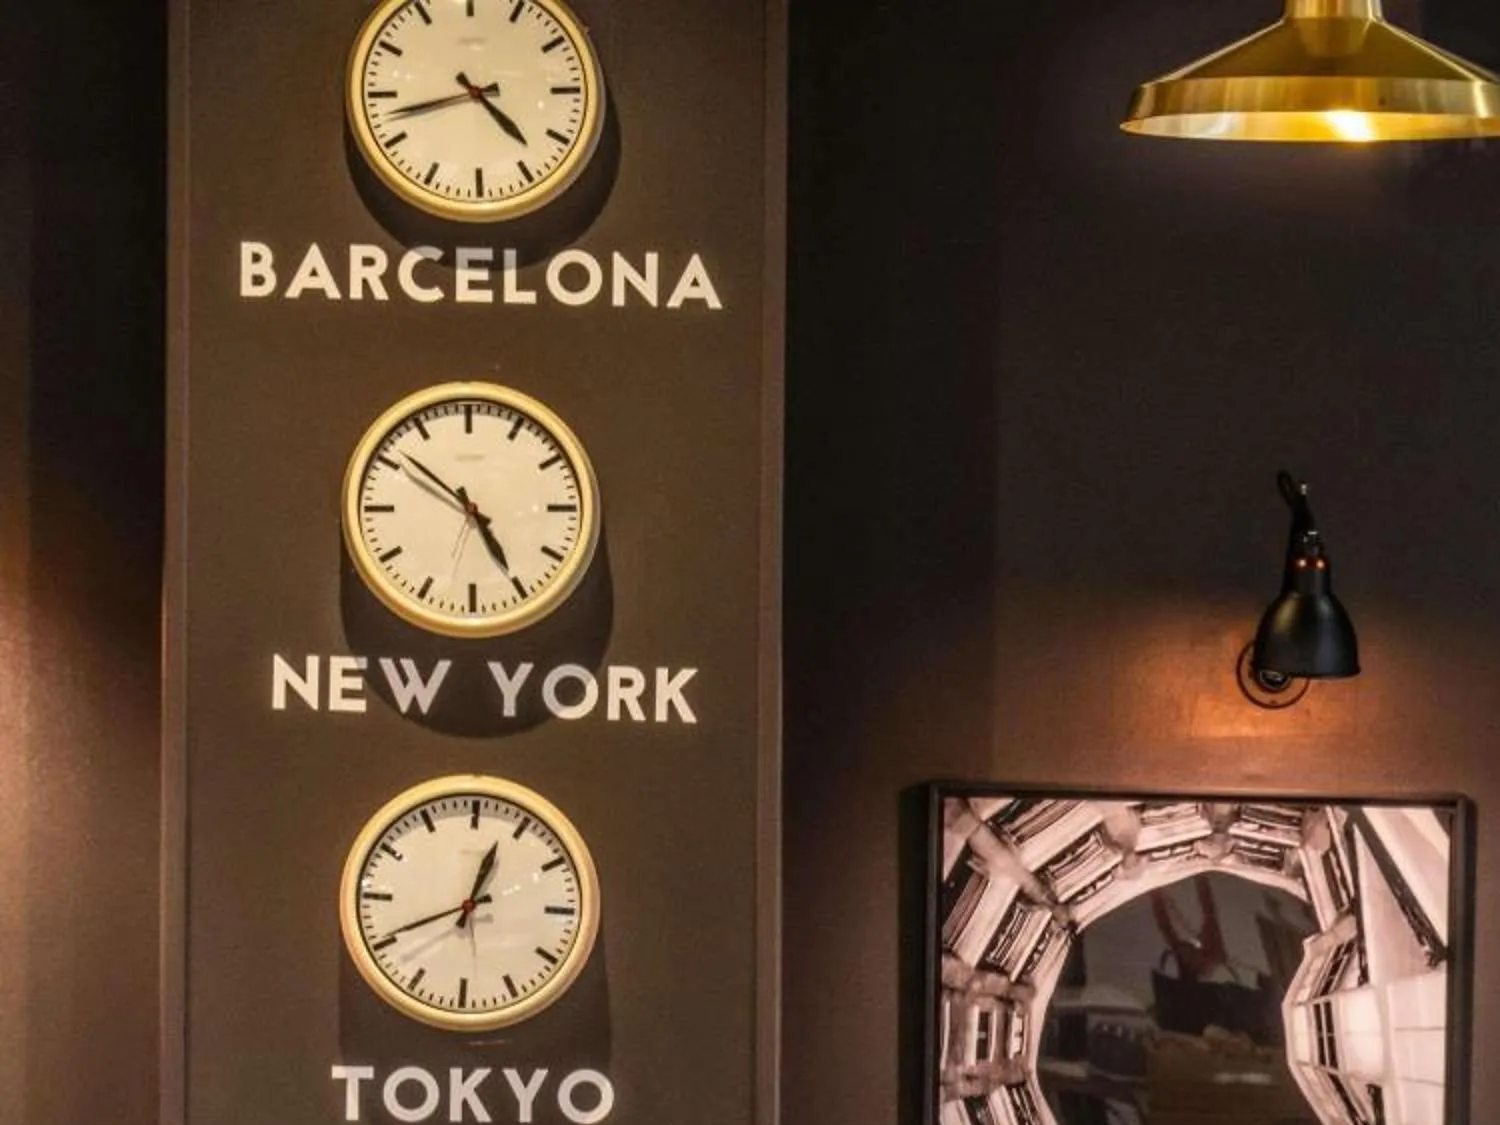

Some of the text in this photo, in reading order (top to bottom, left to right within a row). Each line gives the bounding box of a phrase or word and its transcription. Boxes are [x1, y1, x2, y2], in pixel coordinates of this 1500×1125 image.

[238, 241, 723, 310] BARCELONA
[271, 653, 699, 724] NEW YORK
[331, 1064, 615, 1125] TOKYO
